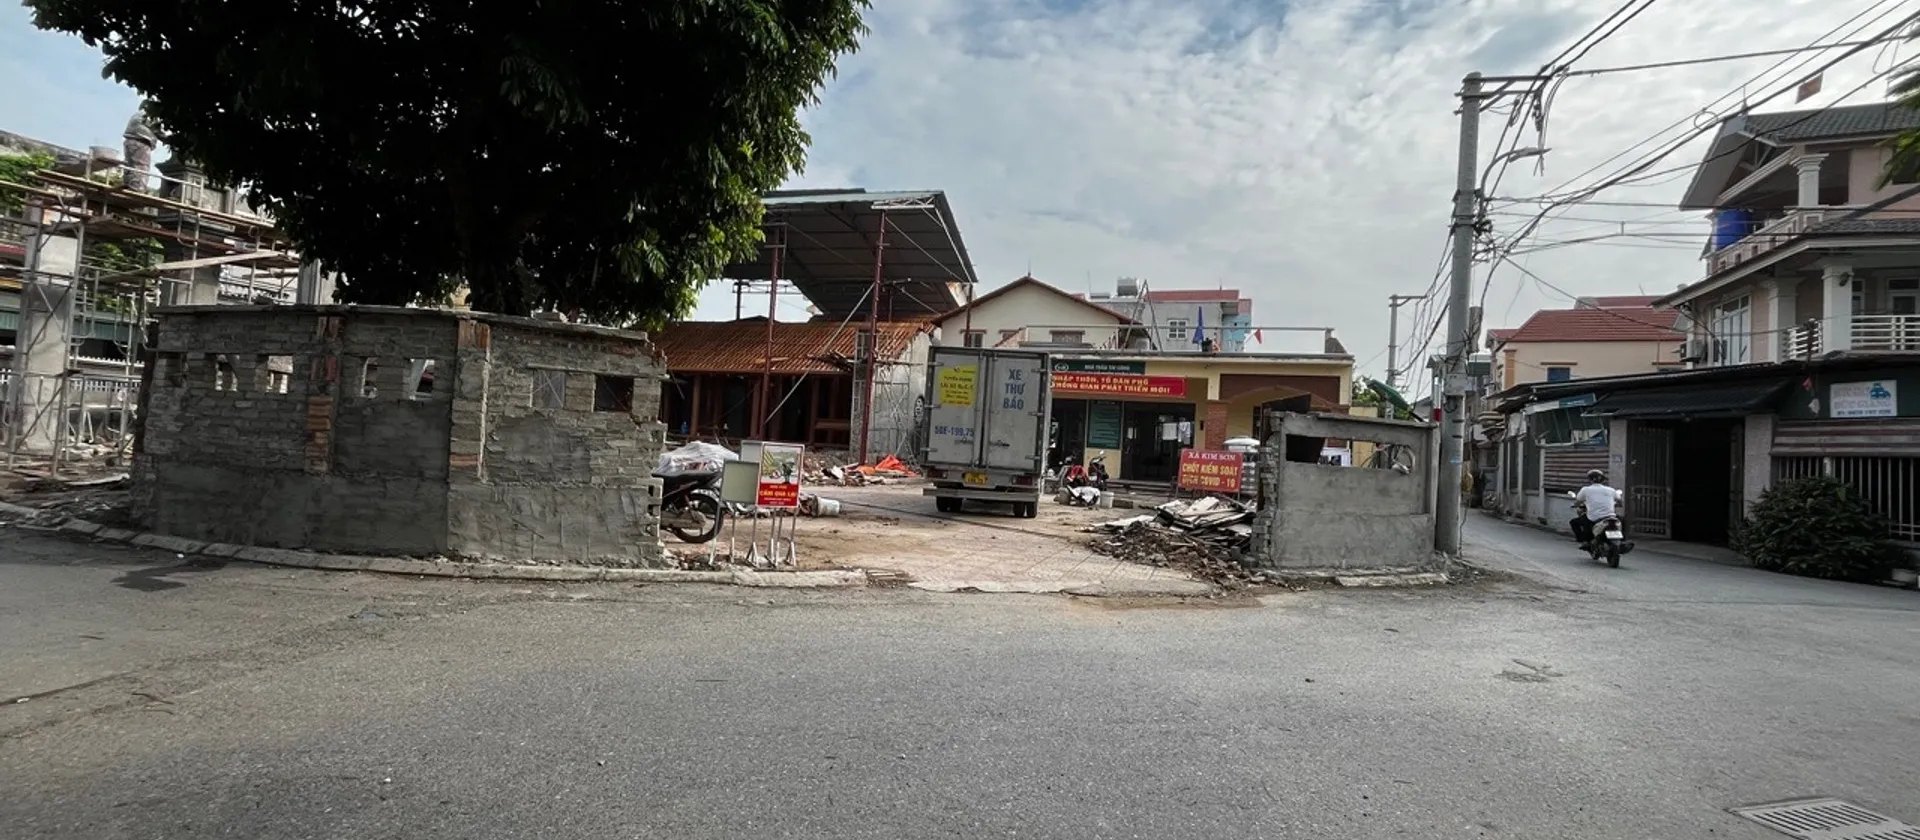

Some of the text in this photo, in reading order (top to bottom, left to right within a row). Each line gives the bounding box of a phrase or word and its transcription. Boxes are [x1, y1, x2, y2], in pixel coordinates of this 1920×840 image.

[1009, 368, 1022, 380] XE
[1005, 382, 1026, 396] THƯ
[1201, 452, 1218, 460] KIM
[1220, 465, 1239, 476] SOÁT
